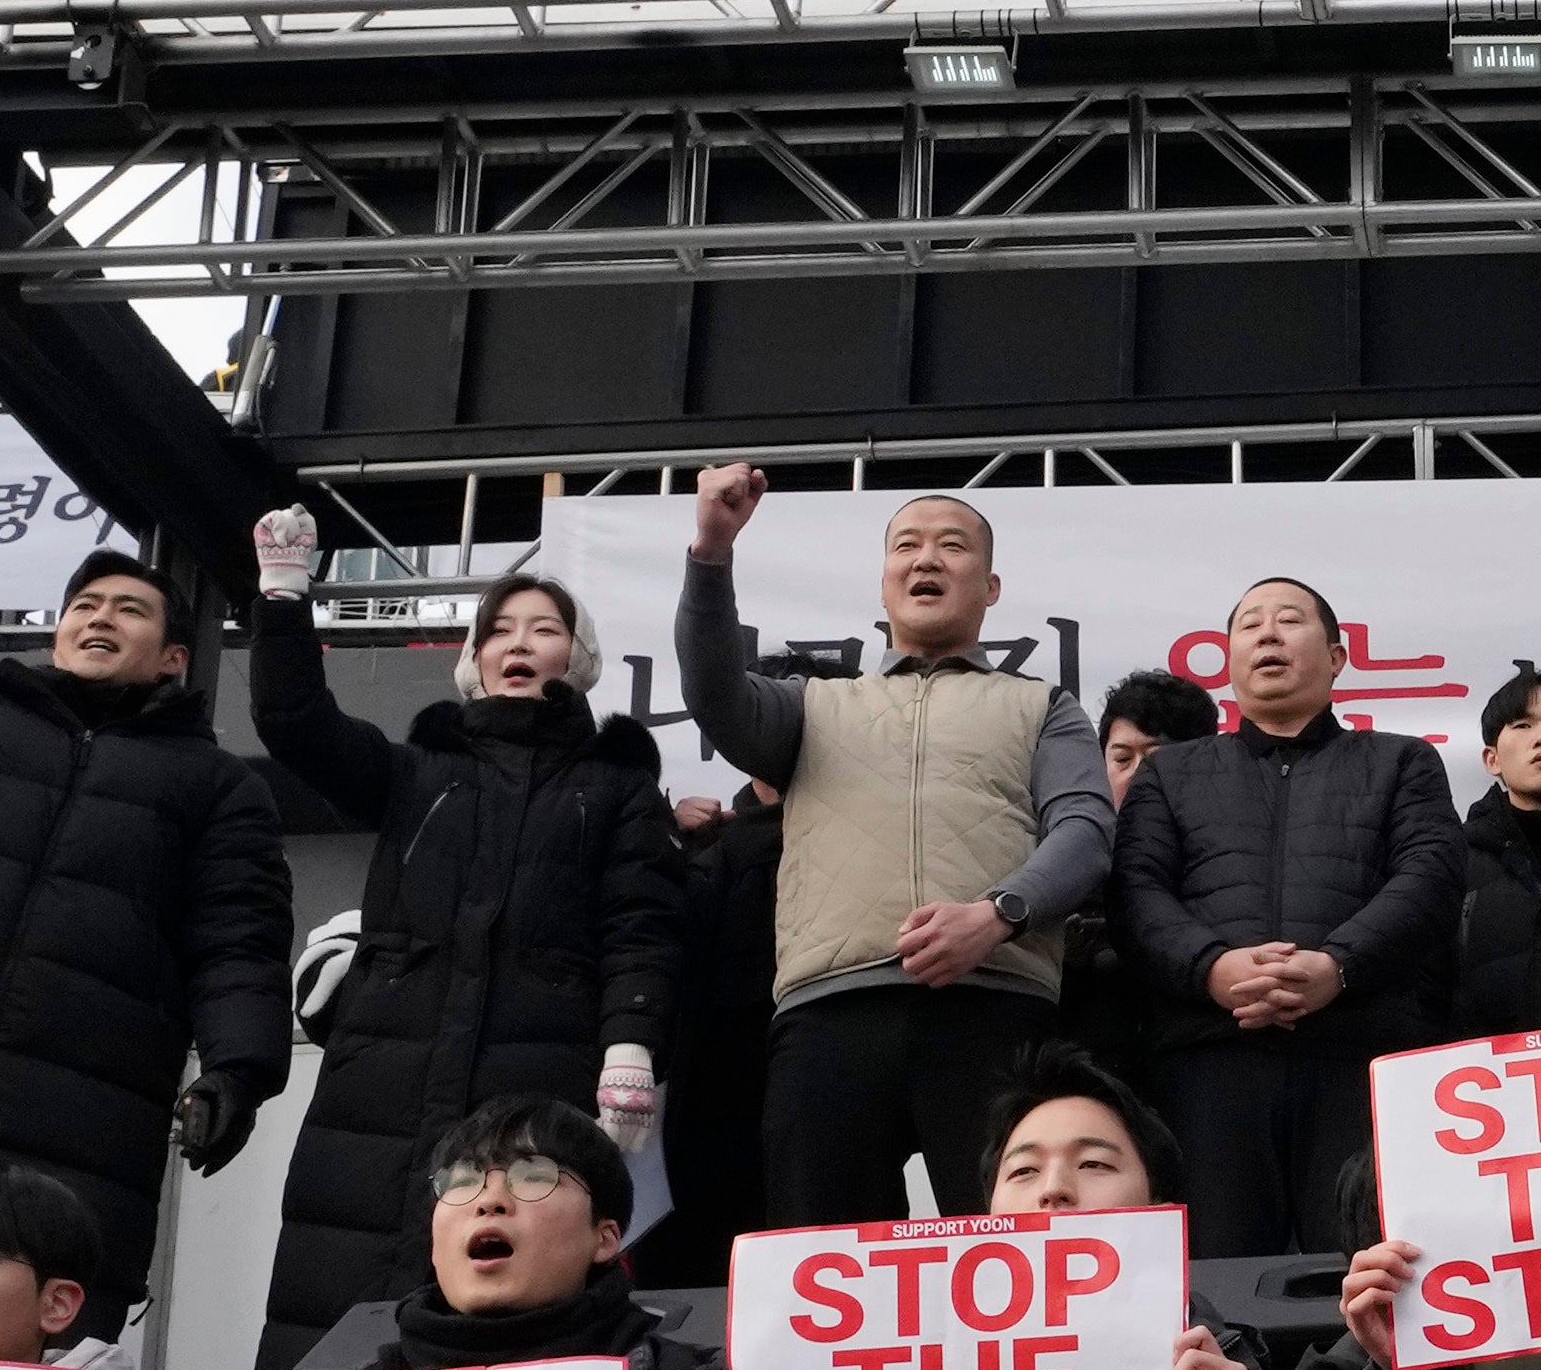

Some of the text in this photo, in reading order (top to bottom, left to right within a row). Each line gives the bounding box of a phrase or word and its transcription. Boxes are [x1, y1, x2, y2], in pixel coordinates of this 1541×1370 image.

[892, 1217, 1015, 1238] SUPPORT YOON
[789, 1237, 1121, 1344] STOP
